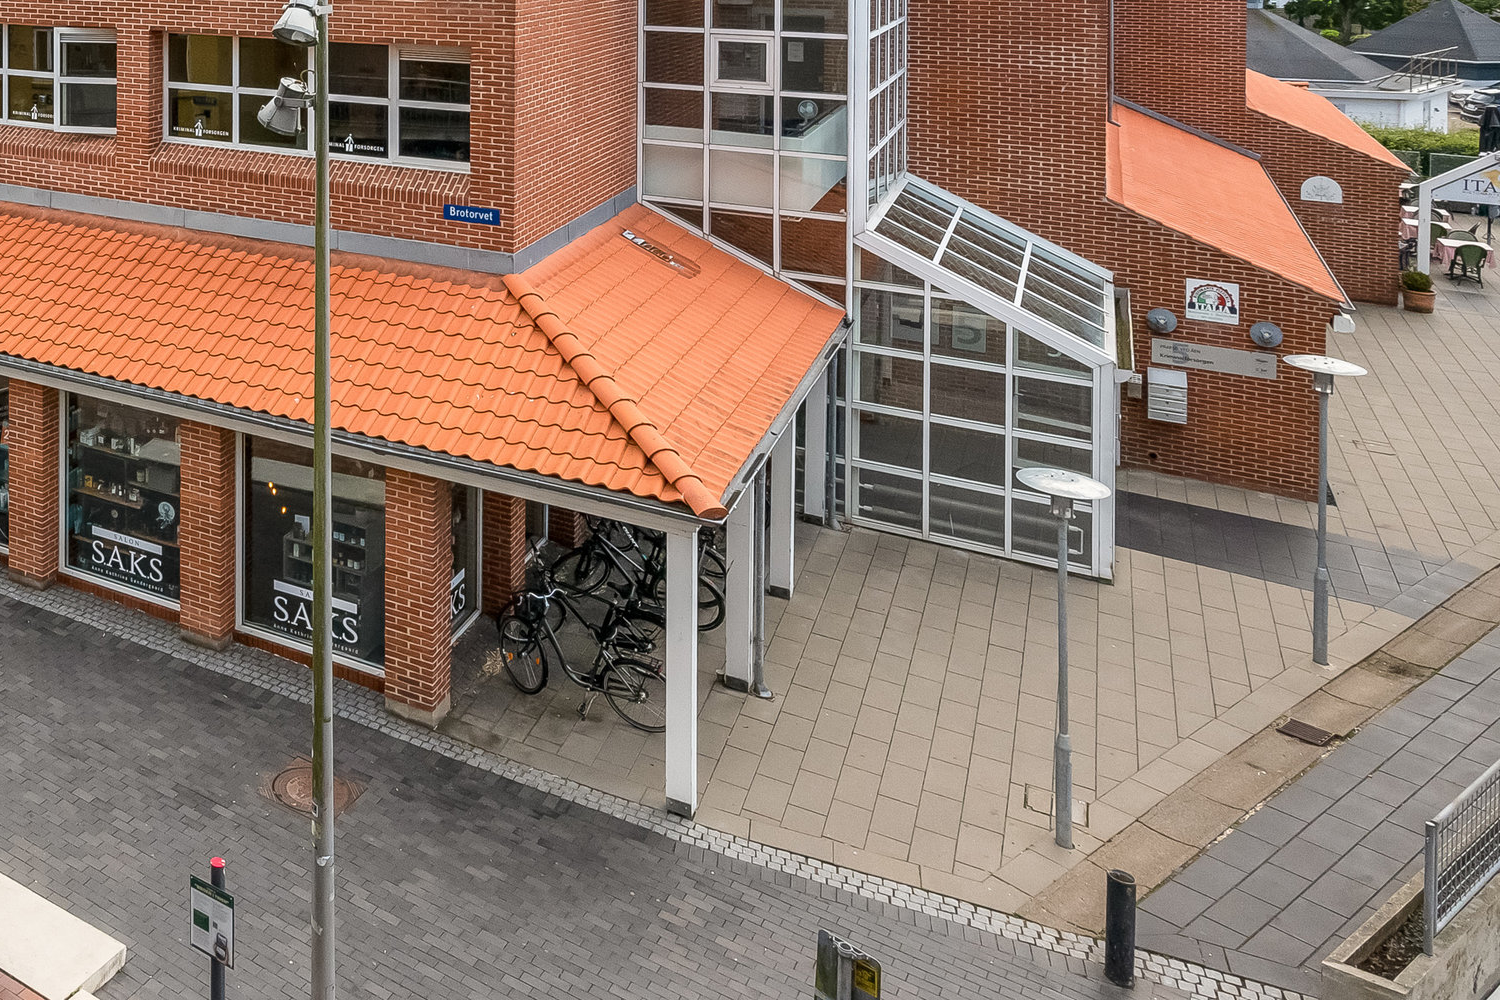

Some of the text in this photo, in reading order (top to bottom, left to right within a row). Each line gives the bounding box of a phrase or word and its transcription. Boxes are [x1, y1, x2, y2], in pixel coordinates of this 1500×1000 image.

[329, 141, 345, 149] MINAL
[449, 206, 493, 221] Brotorvet
[1194, 302, 1232, 314] ITALIA
[113, 533, 140, 547] SALON
